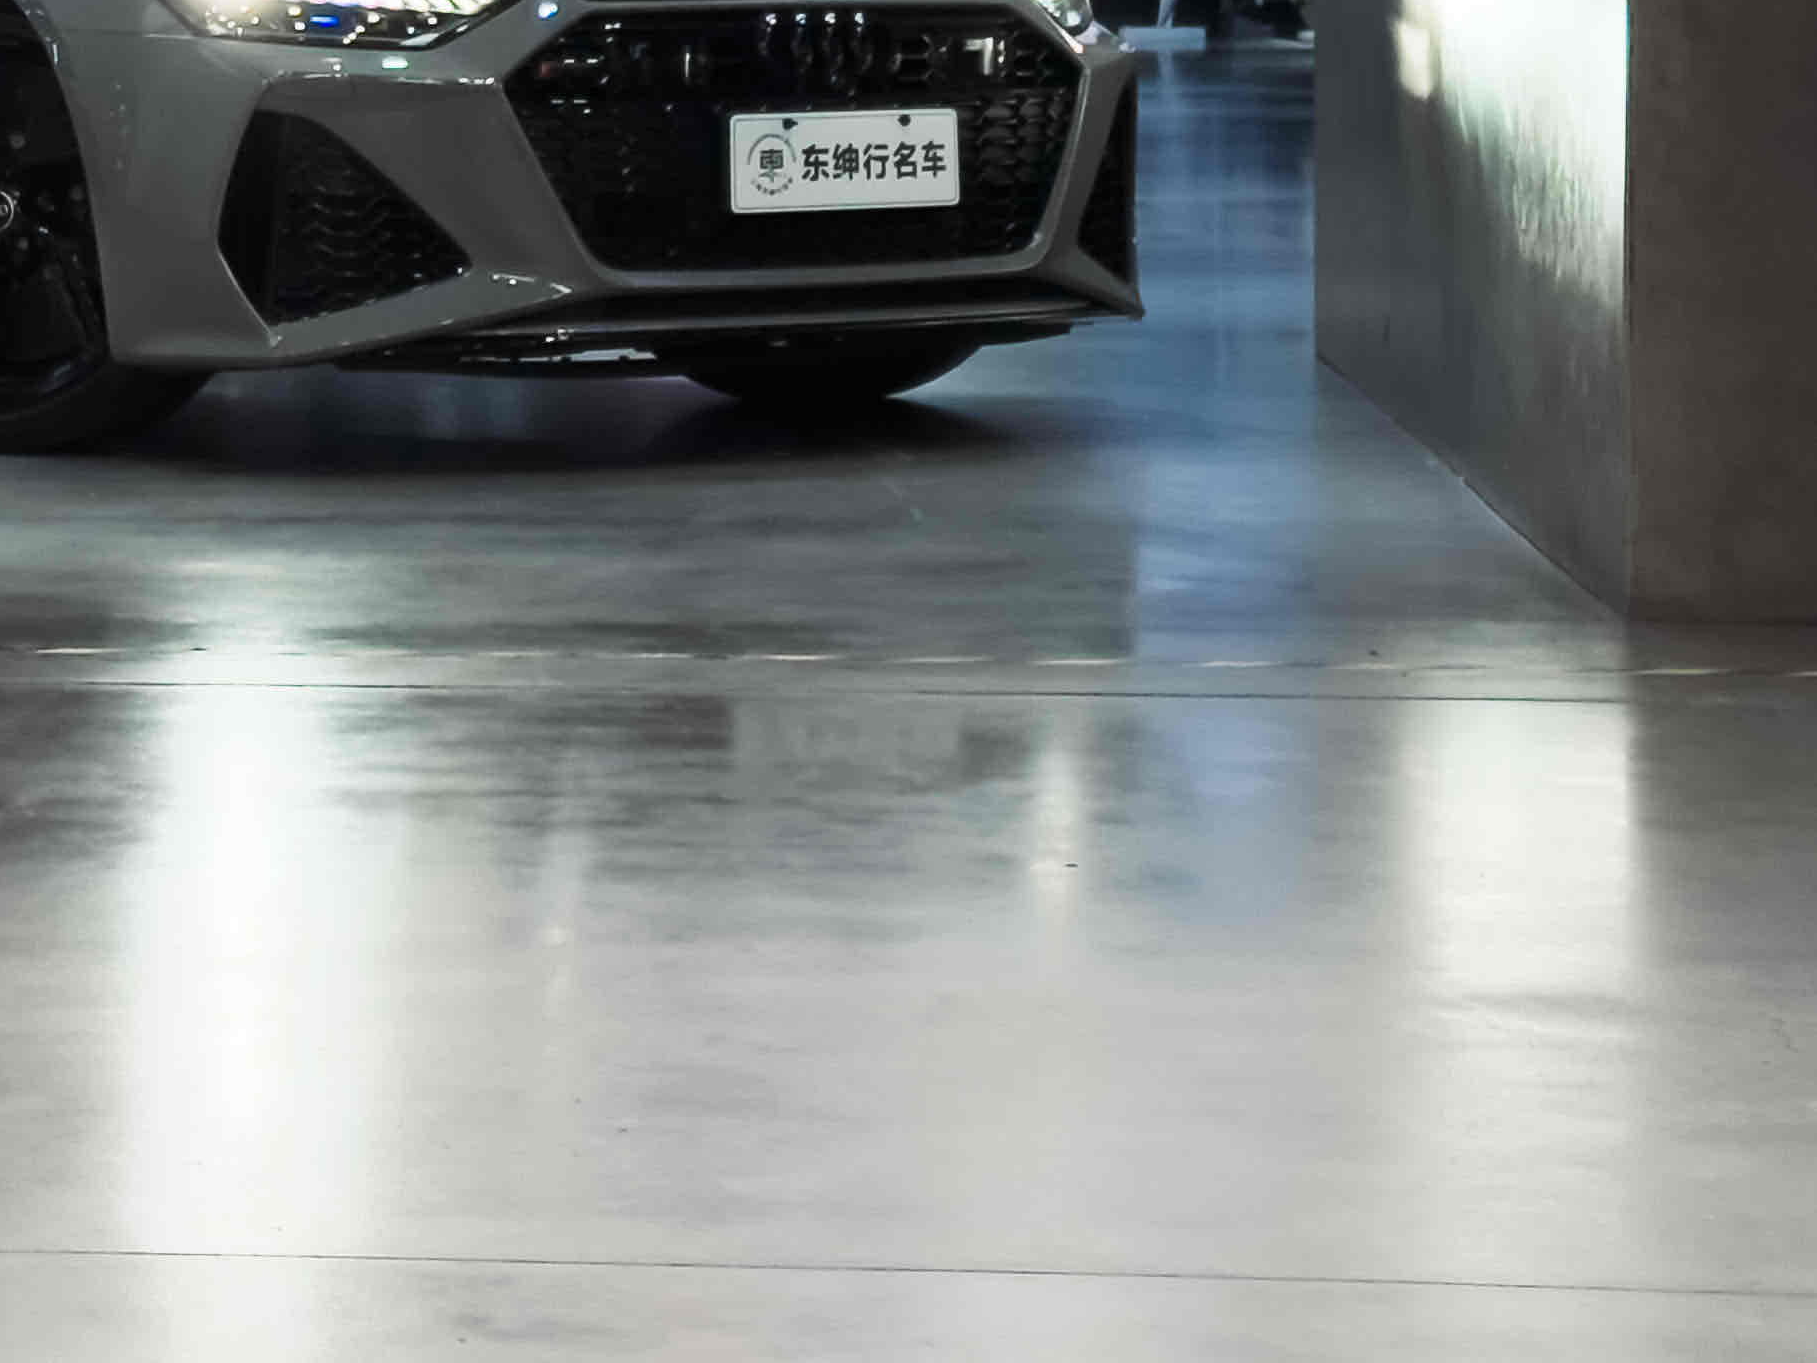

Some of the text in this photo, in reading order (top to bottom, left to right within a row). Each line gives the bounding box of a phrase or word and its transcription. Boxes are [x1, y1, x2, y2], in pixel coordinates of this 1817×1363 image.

[801, 141, 946, 181] 东绅行名车
